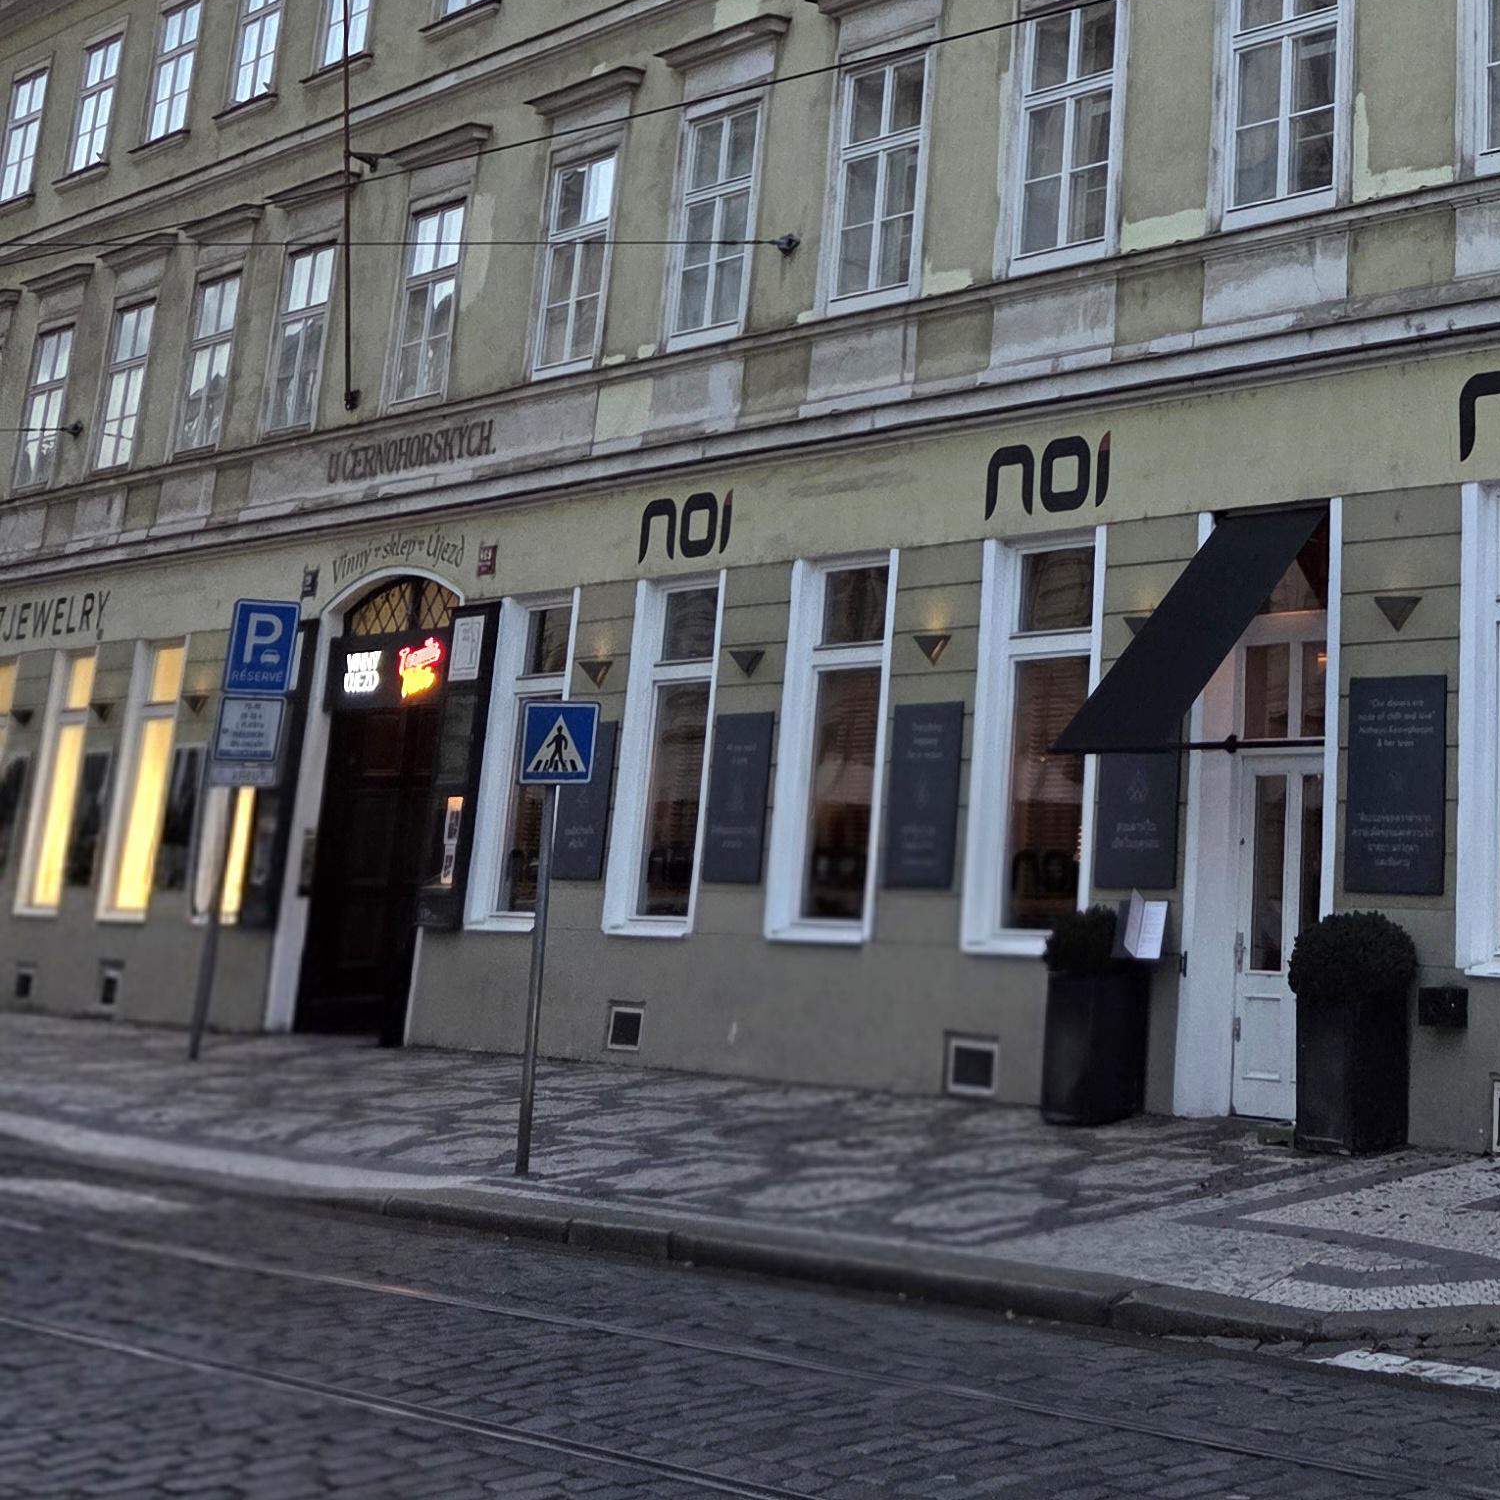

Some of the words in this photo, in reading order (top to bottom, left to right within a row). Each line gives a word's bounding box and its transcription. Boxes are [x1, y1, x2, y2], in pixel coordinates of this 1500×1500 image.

[327, 451, 342, 483] U
[985, 430, 1111, 521] noi
[638, 488, 734, 564] noi
[332, 541, 372, 584] Vinný
[381, 534, 416, 562] sklep
[2, 590, 111, 642] JEWELRY
[243, 612, 283, 664] P
